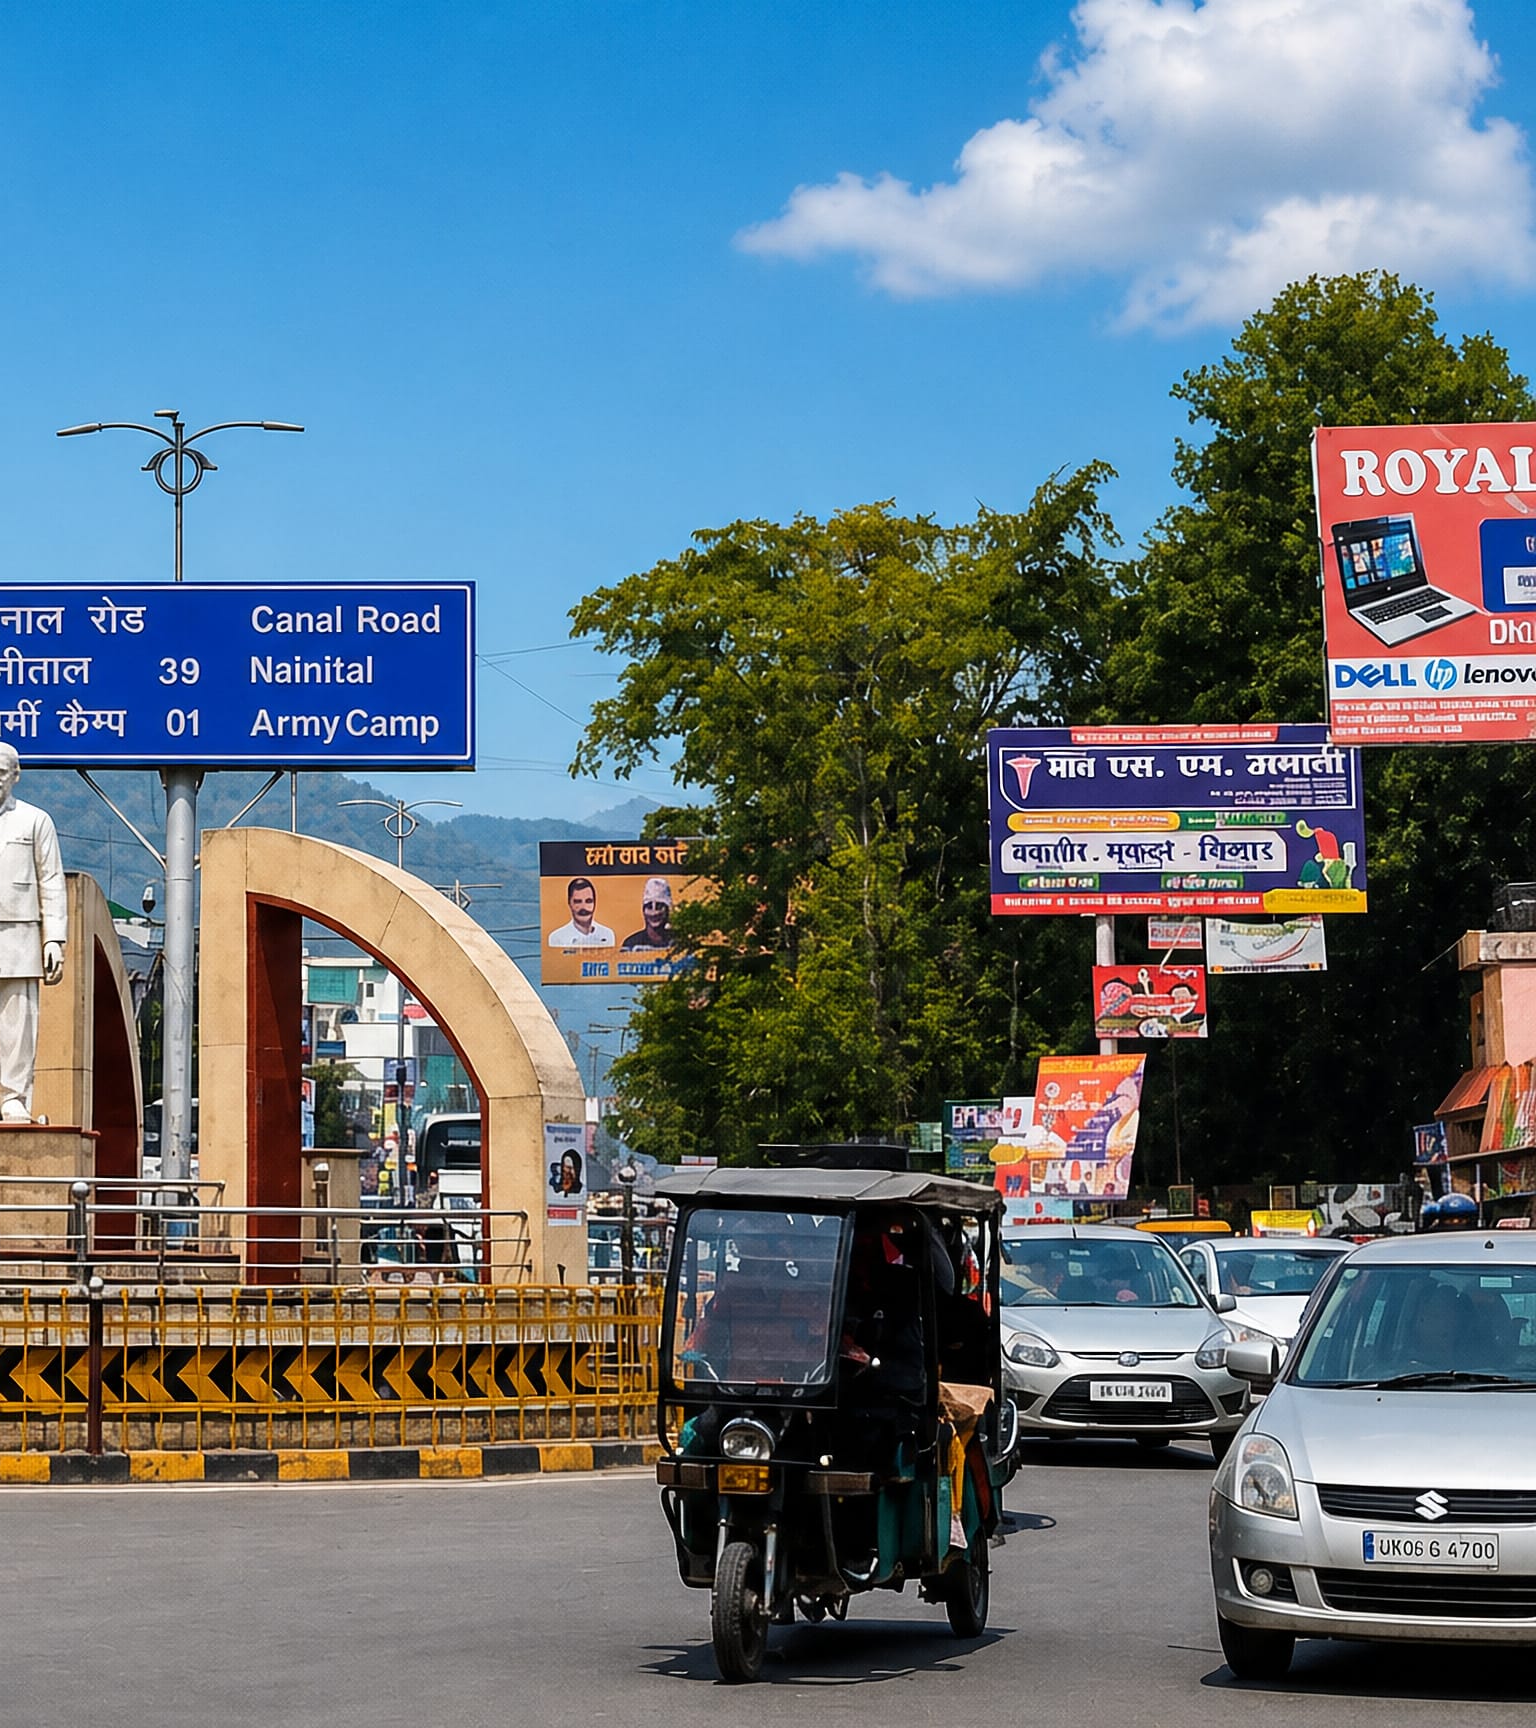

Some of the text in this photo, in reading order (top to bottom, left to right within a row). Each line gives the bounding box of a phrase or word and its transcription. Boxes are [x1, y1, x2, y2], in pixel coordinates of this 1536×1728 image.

[1340, 446, 1536, 496] ROYAL
[87, 596, 147, 634] रोड
[251, 604, 441, 633] Canal Road
[159, 658, 200, 684] 39
[250, 656, 374, 683] Nainital
[1335, 663, 1417, 689] DELL
[56, 699, 128, 738] कैम्प
[166, 709, 200, 736] 01
[250, 709, 440, 744] Army Camp
[1379, 1539, 1424, 1557] UK06
[1447, 1541, 1496, 1559] 4700
